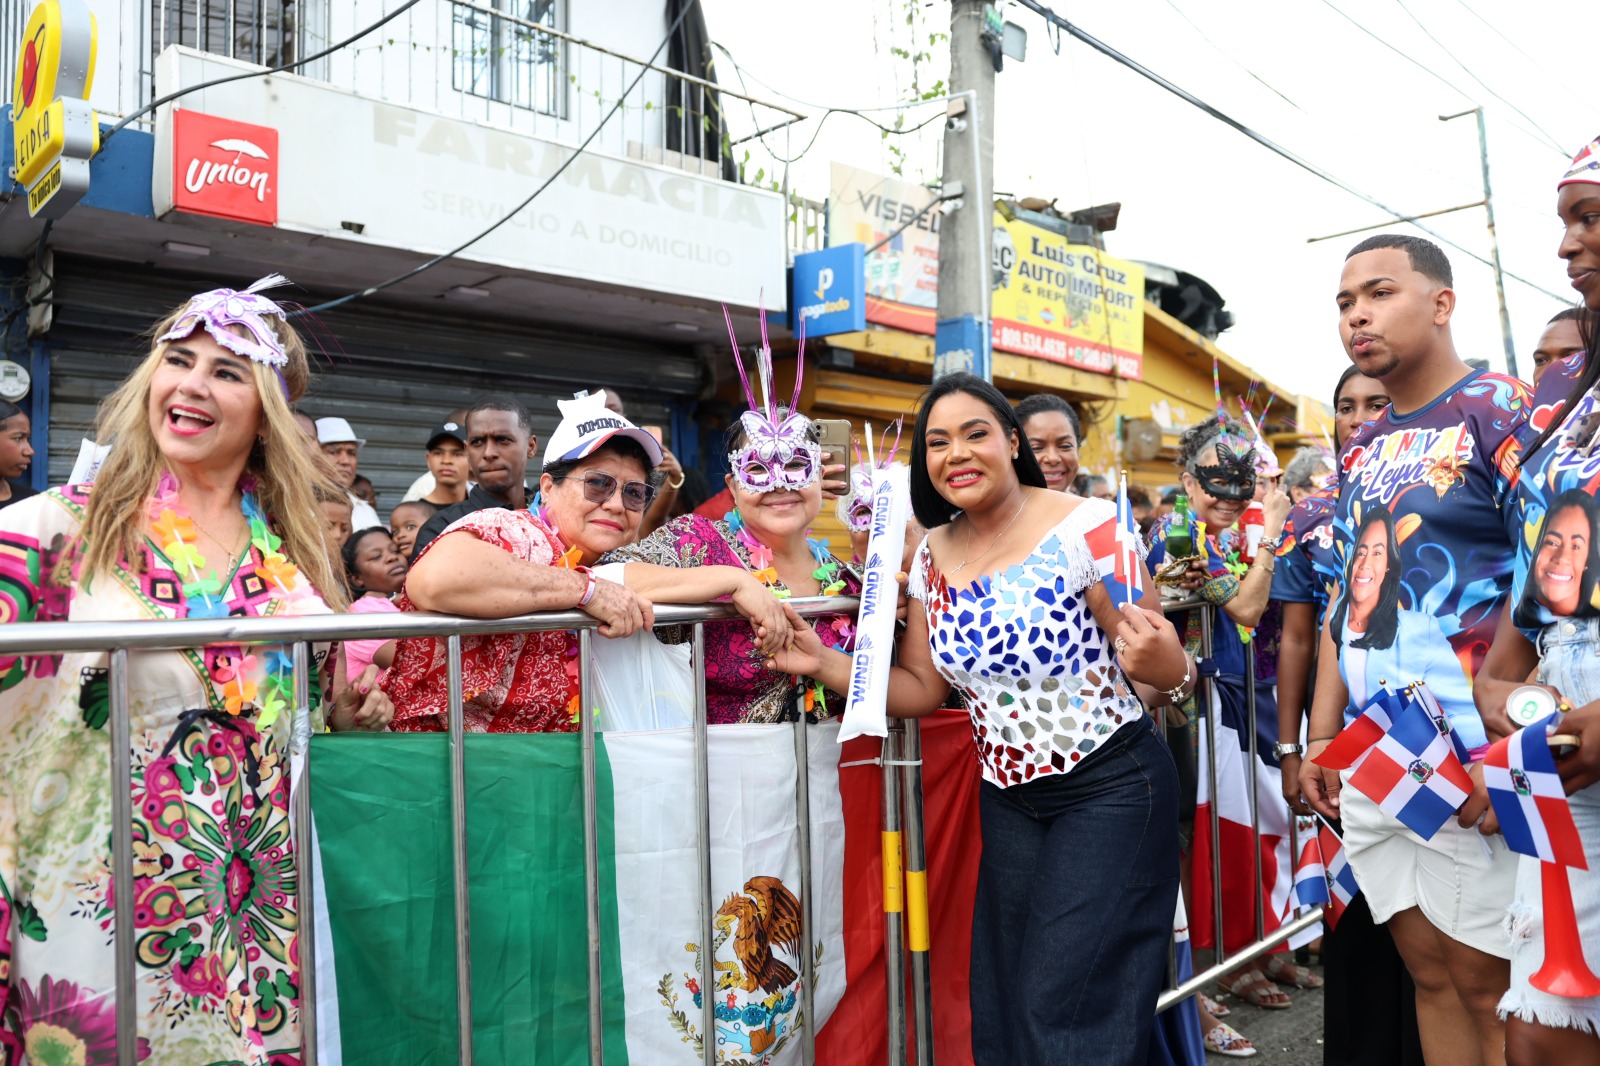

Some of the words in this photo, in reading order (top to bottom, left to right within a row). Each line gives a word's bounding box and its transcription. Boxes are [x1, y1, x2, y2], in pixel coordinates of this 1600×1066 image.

[15, 110, 50, 174] LEIDSA
[373, 105, 767, 229] FARMACIA
[185, 157, 269, 202] Union
[421, 189, 561, 234] SERVICIO
[570, 219, 590, 241] A
[599, 227, 733, 268] DOMICILIO
[1018, 260, 1067, 289] AUTO
[1072, 275, 1135, 310] IMPORT
[1031, 236, 1075, 267] Luis
[1082, 255, 1127, 285] Cruz
[1355, 424, 1471, 468] CARNAVAL
[1364, 459, 1426, 500] Leyvi
[872, 496, 890, 543] WIND
[862, 571, 880, 623] WIND
[851, 653, 870, 711] WIND
